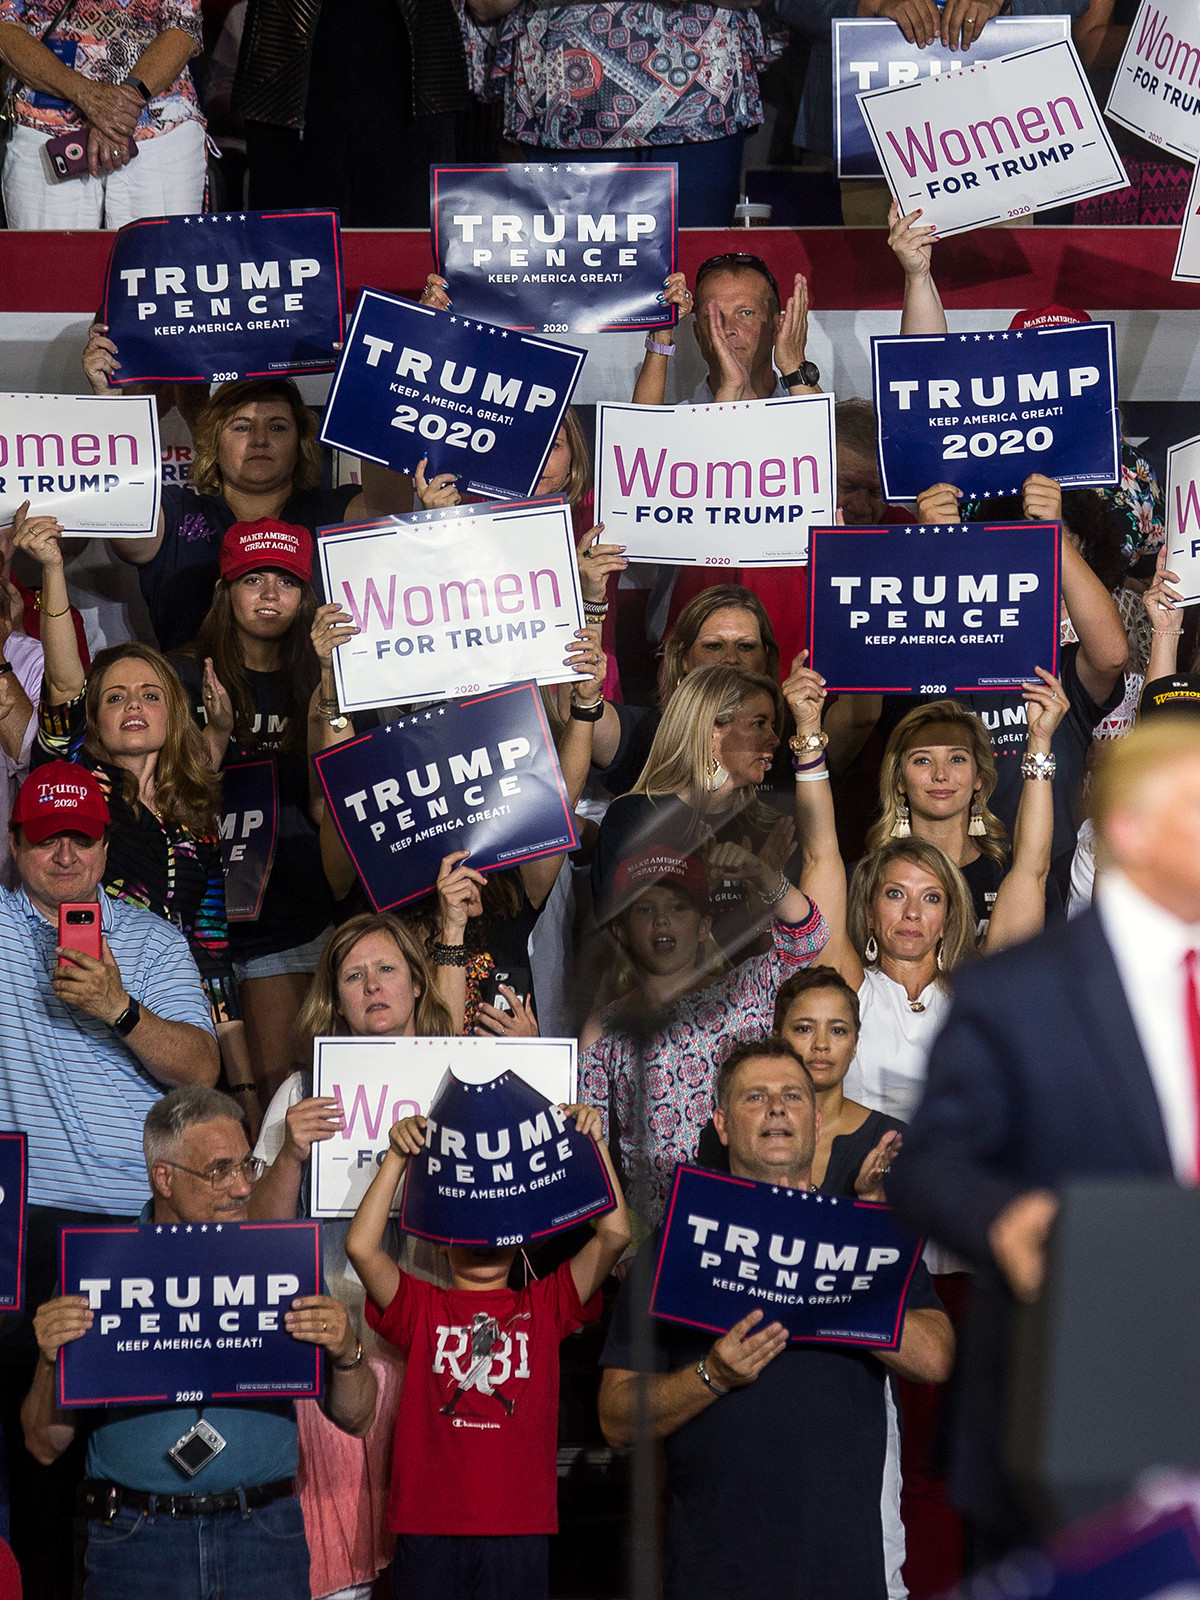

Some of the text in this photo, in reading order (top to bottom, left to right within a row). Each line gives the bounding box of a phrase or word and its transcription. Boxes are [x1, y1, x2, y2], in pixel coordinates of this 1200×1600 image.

[1133, 70, 1159, 95] FOR
[886, 96, 1084, 178] Women
[1148, 132, 1163, 144] 2020
[926, 143, 1074, 199] FOR TRUMP
[1007, 205, 1031, 217] 2020
[453, 214, 658, 243] TRUMP
[473, 248, 638, 267] PENCE
[120, 258, 321, 297] TRUMP
[488, 273, 623, 283] KEEP AMERICA GREAT!
[138, 293, 304, 321] PENCE
[154, 319, 290, 336] KEEP AMERICA GREAT!
[542, 323, 569, 333] 2020
[1023, 315, 1081, 328] MAKE AMERIC
[212, 372, 238, 382] 2020
[362, 334, 557, 413] TRUMP
[889, 366, 1100, 410] TRUMP
[389, 382, 514, 426] KEEP AMERICA GREAT!
[929, 406, 1064, 427] KEEP AMERICA GREAT!
[390, 404, 496, 453] 2020
[0, 433, 139, 467] men
[942, 426, 1054, 460] 2020
[18, 474, 120, 493] TRUMP
[613, 444, 819, 499] Women
[636, 504, 804, 524] FOR TRUMP
[239, 531, 299, 546] MAKE AMERICA
[244, 541, 297, 553] GREAT AGAIN
[705, 557, 731, 565] 2020
[341, 568, 562, 634] Women
[830, 573, 1039, 605] TRUMP
[850, 608, 1019, 629] PENCE
[375, 619, 546, 660] FOR TRUMP
[865, 634, 1004, 645] KEEP AMERICA GREAT!
[454, 683, 480, 694] 2020
[920, 684, 947, 694] 2020
[997, 734, 1023, 745] GREAT
[37, 784, 88, 800] Trump
[344, 736, 531, 823] TRUMP
[54, 799, 78, 808] 2020
[370, 775, 522, 843] PENCE
[389, 805, 511, 854] KEEP AMERICA GREAT!
[648, 856, 688, 870] AMERICA
[658, 865, 685, 877] AGAIN
[423, 1105, 568, 1160] TRUMP
[427, 1139, 574, 1184] PENCE
[438, 1169, 566, 1200] KEEP AMERICA GREAT!
[496, 1234, 524, 1246] 2020
[687, 1214, 901, 1273] TRUMP
[700, 1251, 874, 1292] PENCE
[79, 1273, 300, 1310] TRUMP
[712, 1277, 852, 1305] KEEP AMERICA GREAT!
[100, 1310, 279, 1335] PENCE
[117, 1337, 262, 1352] KEEP AMERICA GREAT!
[432, 1324, 531, 1385] RBI
[175, 1391, 203, 1402] 2020
[452, 1417, 501, 1430] Champion
